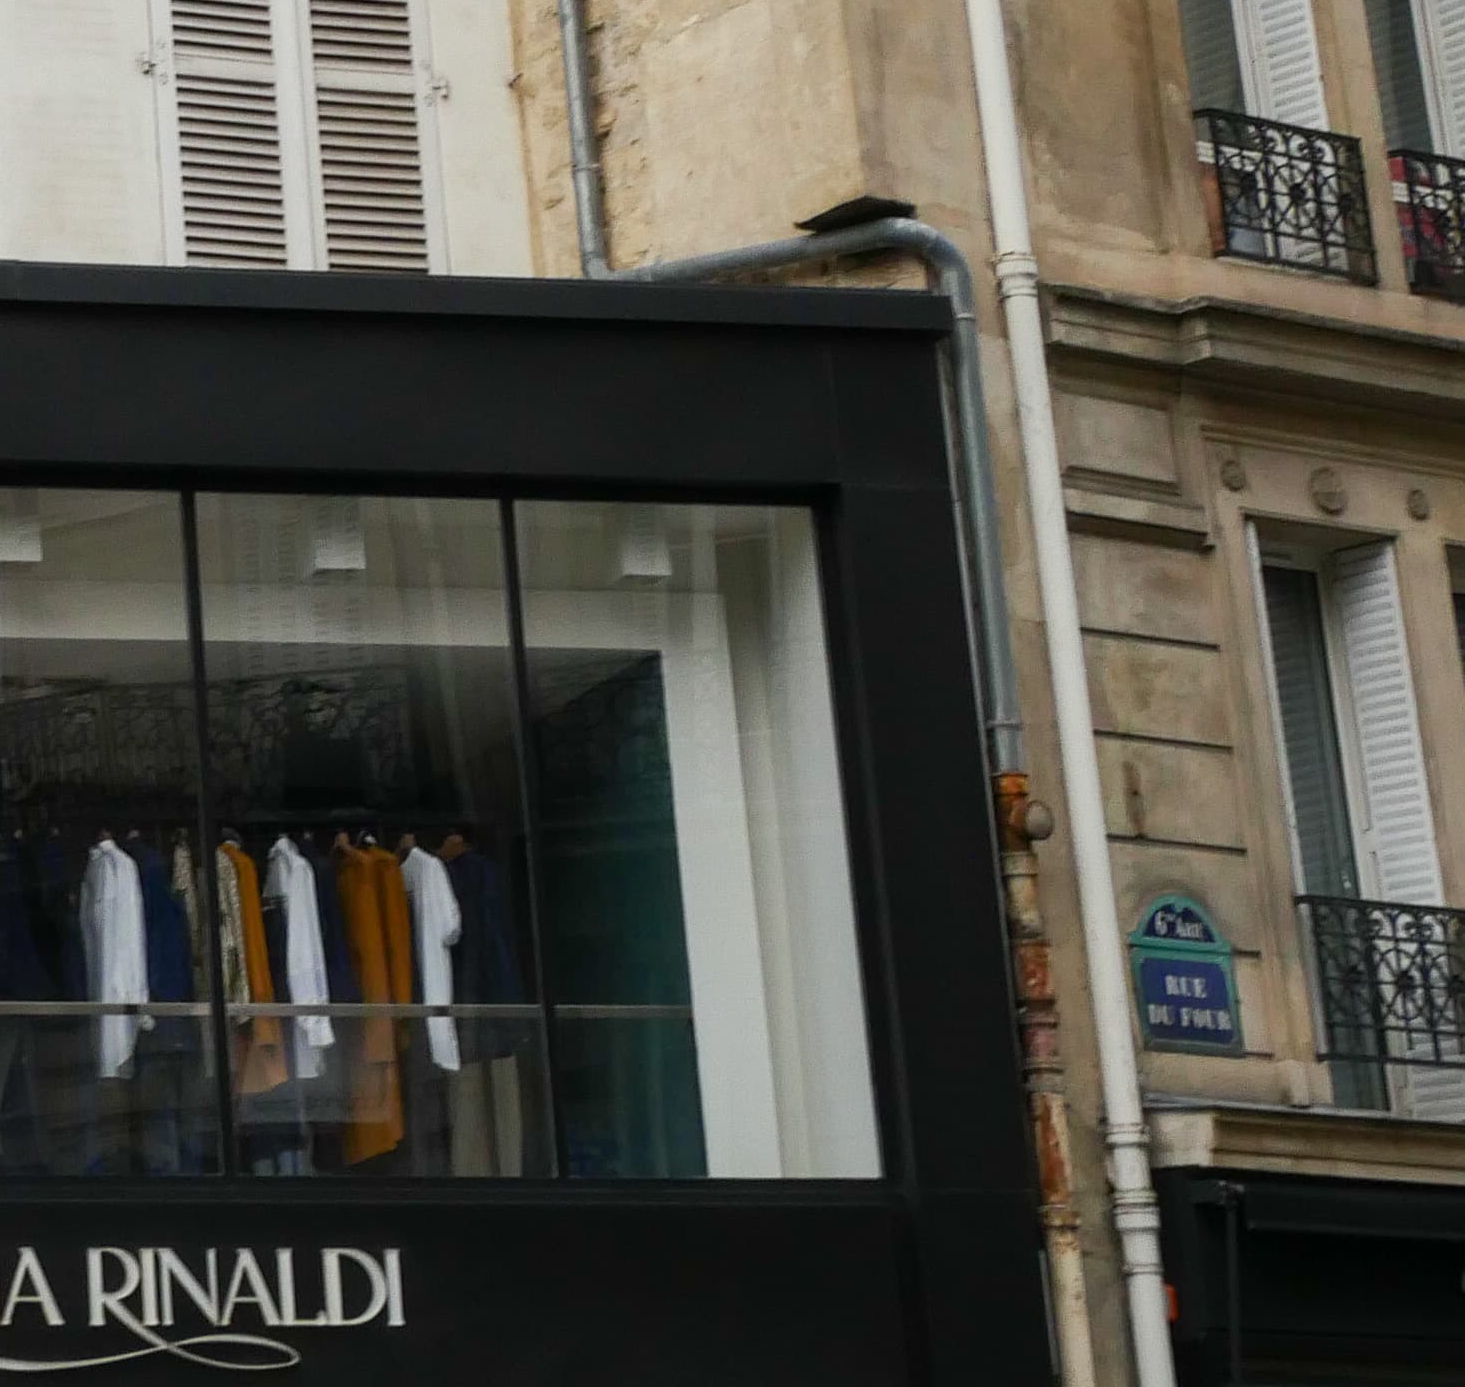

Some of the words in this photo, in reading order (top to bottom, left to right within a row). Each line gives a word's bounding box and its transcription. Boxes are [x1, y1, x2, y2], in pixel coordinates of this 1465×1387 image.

[1165, 975, 1207, 999] RUE
[1148, 1004, 1175, 1026] DU
[1180, 1007, 1232, 1031] FOUR
[86, 1246, 406, 1370] RINALDI
